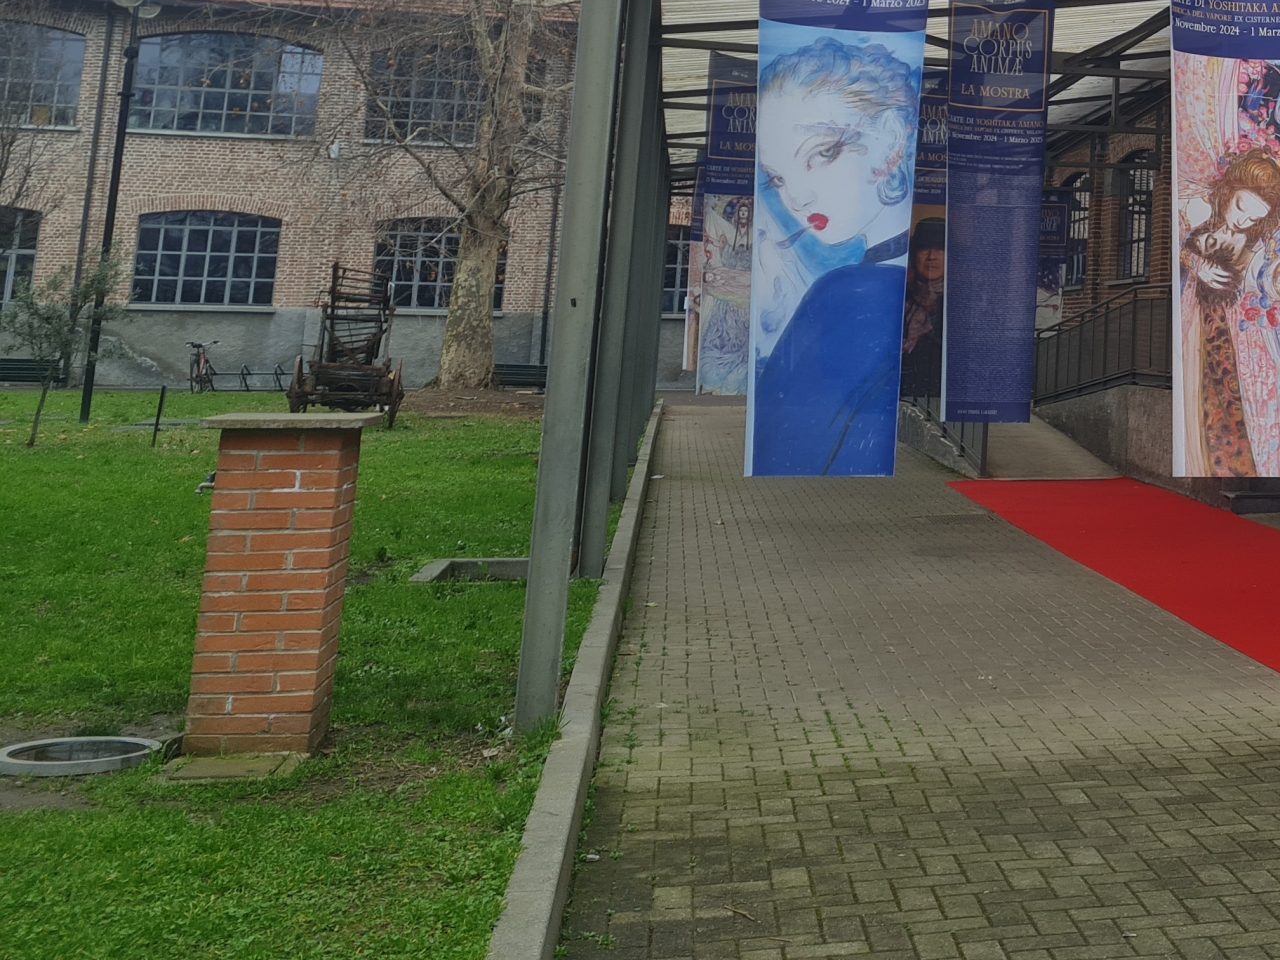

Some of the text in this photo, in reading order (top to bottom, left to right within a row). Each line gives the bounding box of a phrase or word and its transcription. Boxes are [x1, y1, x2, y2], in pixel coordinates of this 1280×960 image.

[1192, 9, 1204, 18] DEL
[1206, 12, 1232, 22] VAPORE
[970, 19, 1028, 41] AMANO
[1175, 17, 1217, 33] Novembre
[1219, 24, 1240, 36] 2024
[963, 36, 1033, 59] CORPUS
[961, 83, 1030, 99] LA MOSTRA
[722, 105, 756, 120] COR
[922, 103, 948, 117] AMAN
[728, 119, 756, 133] ANIM
[918, 116, 948, 132] COR
[921, 130, 948, 144] ANIM
[720, 140, 731, 150] LA
[928, 152, 948, 162] MOS
